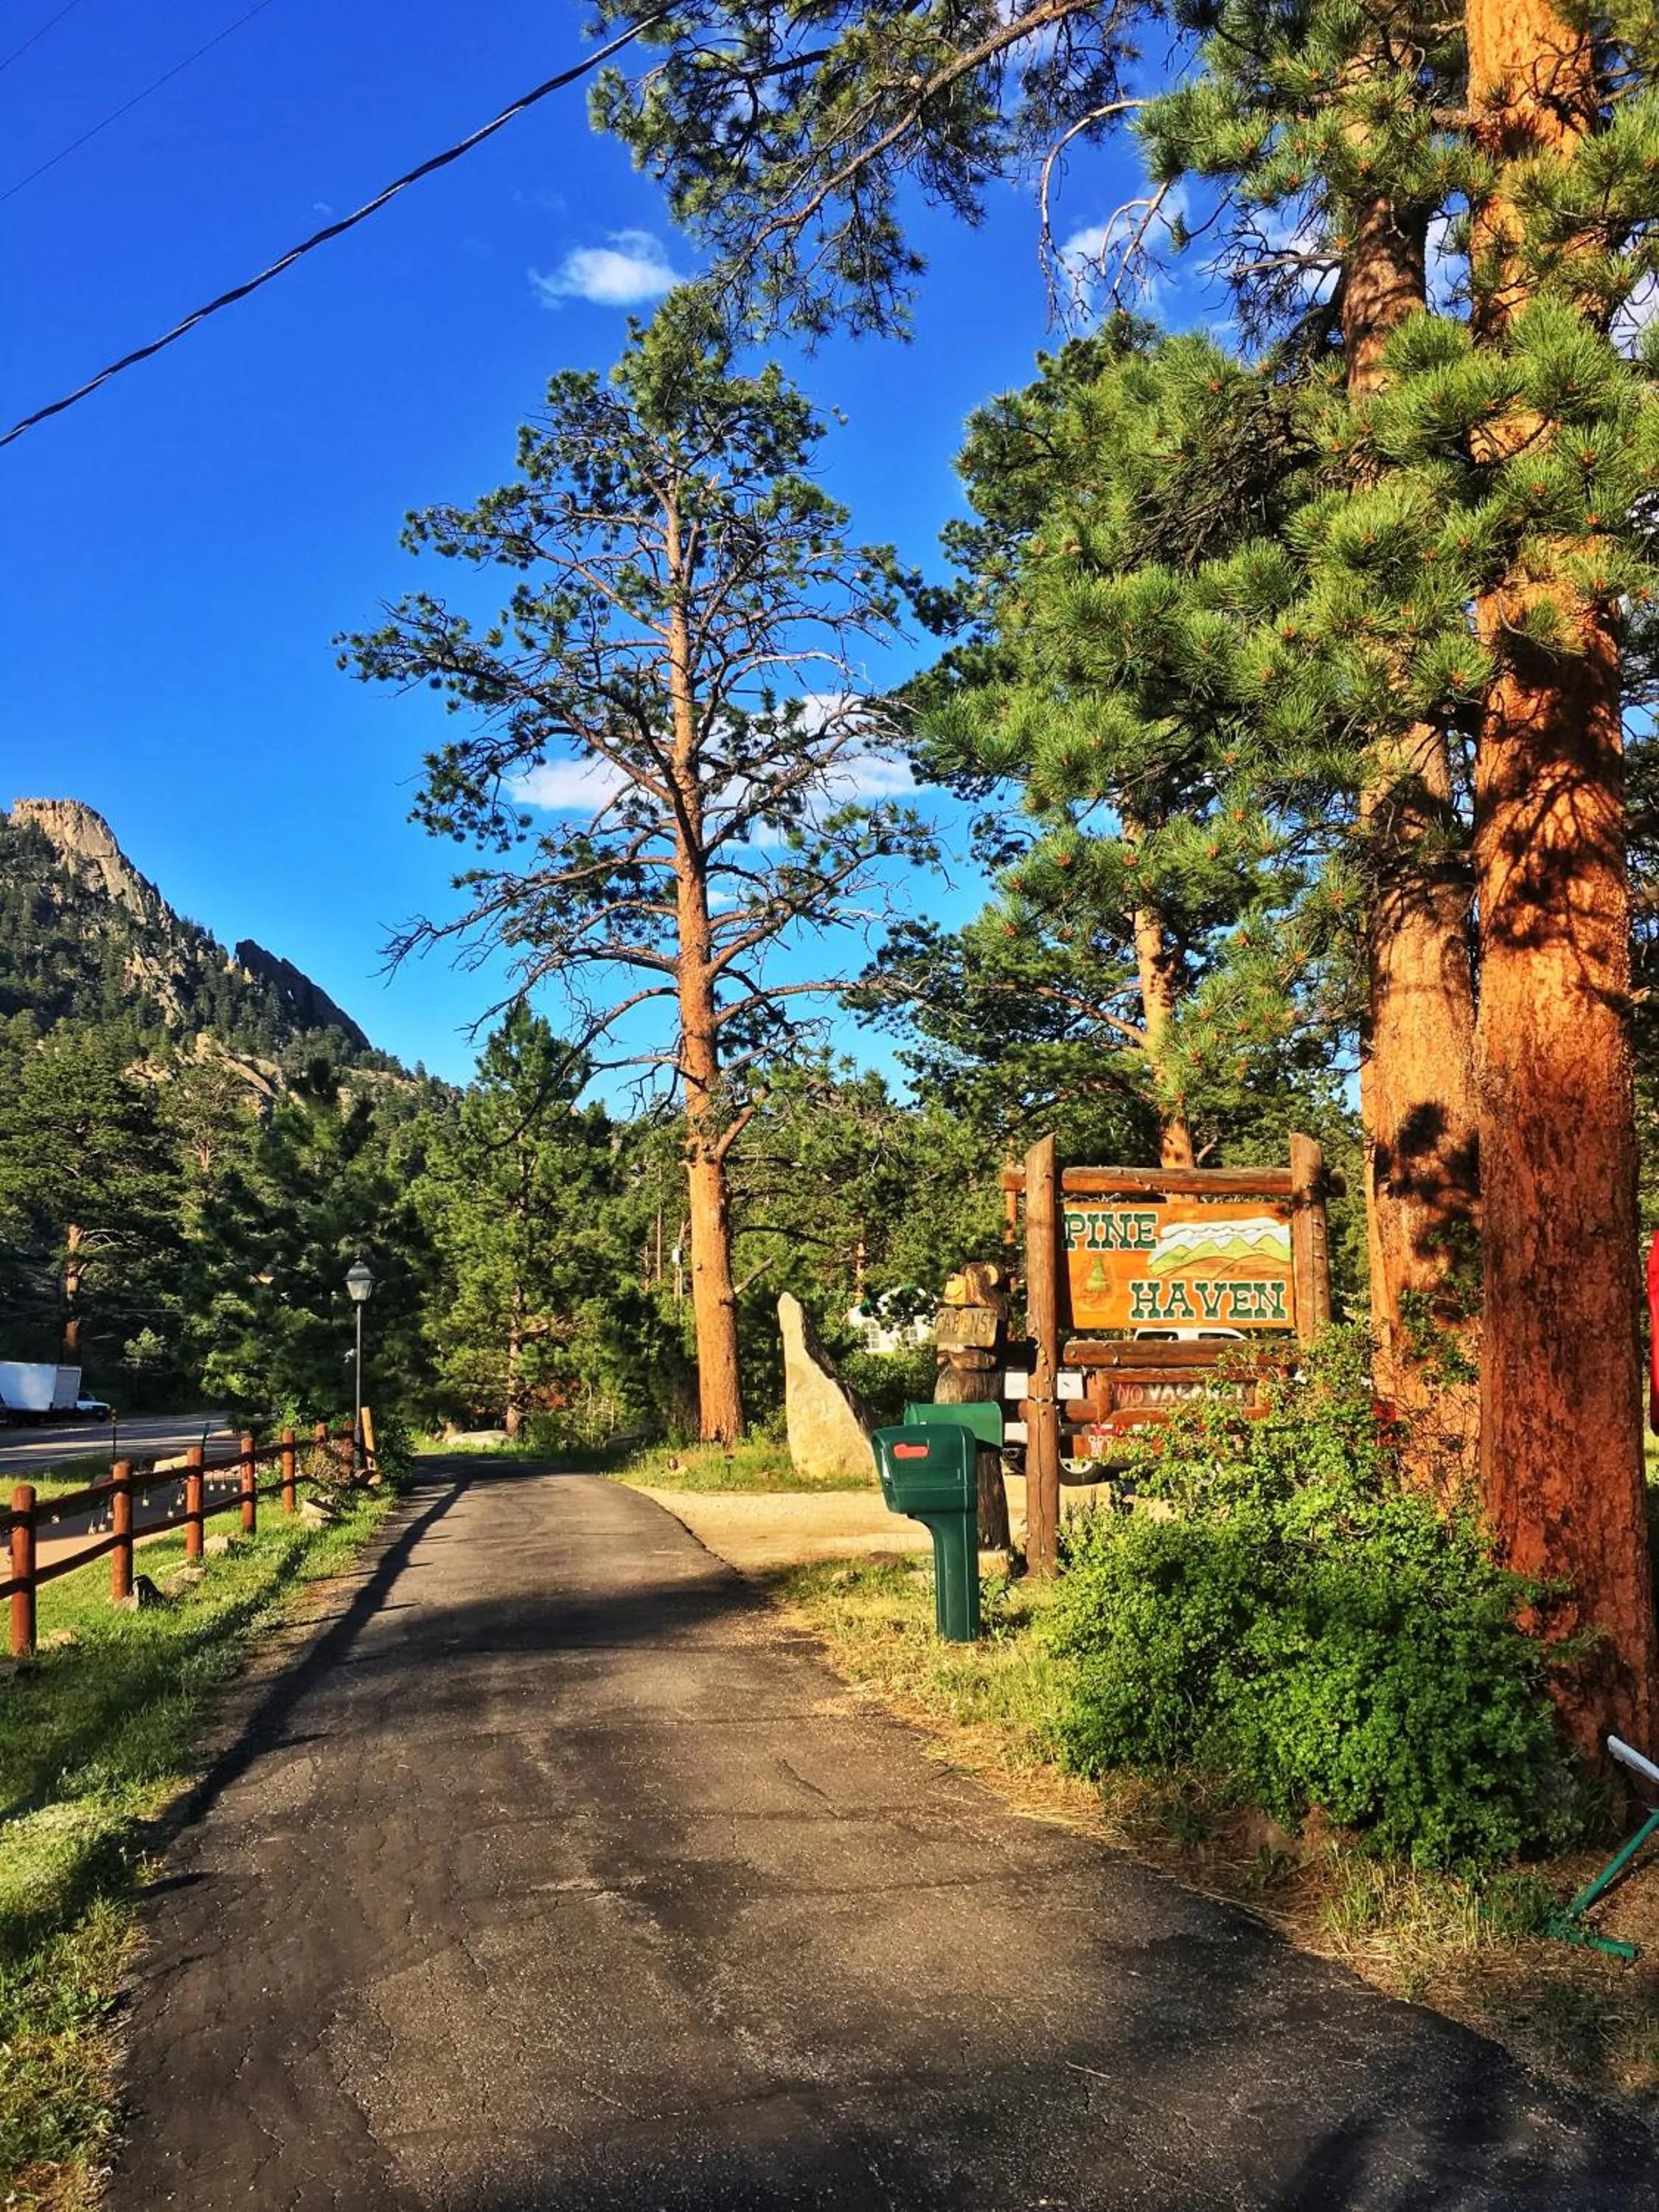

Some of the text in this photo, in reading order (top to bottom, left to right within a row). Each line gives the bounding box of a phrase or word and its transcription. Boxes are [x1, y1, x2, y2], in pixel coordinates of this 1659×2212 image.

[1062, 1211, 1158, 1251] PINE
[1129, 1279, 1287, 1321] HAVEN
[1117, 1382, 1144, 1402] NO
